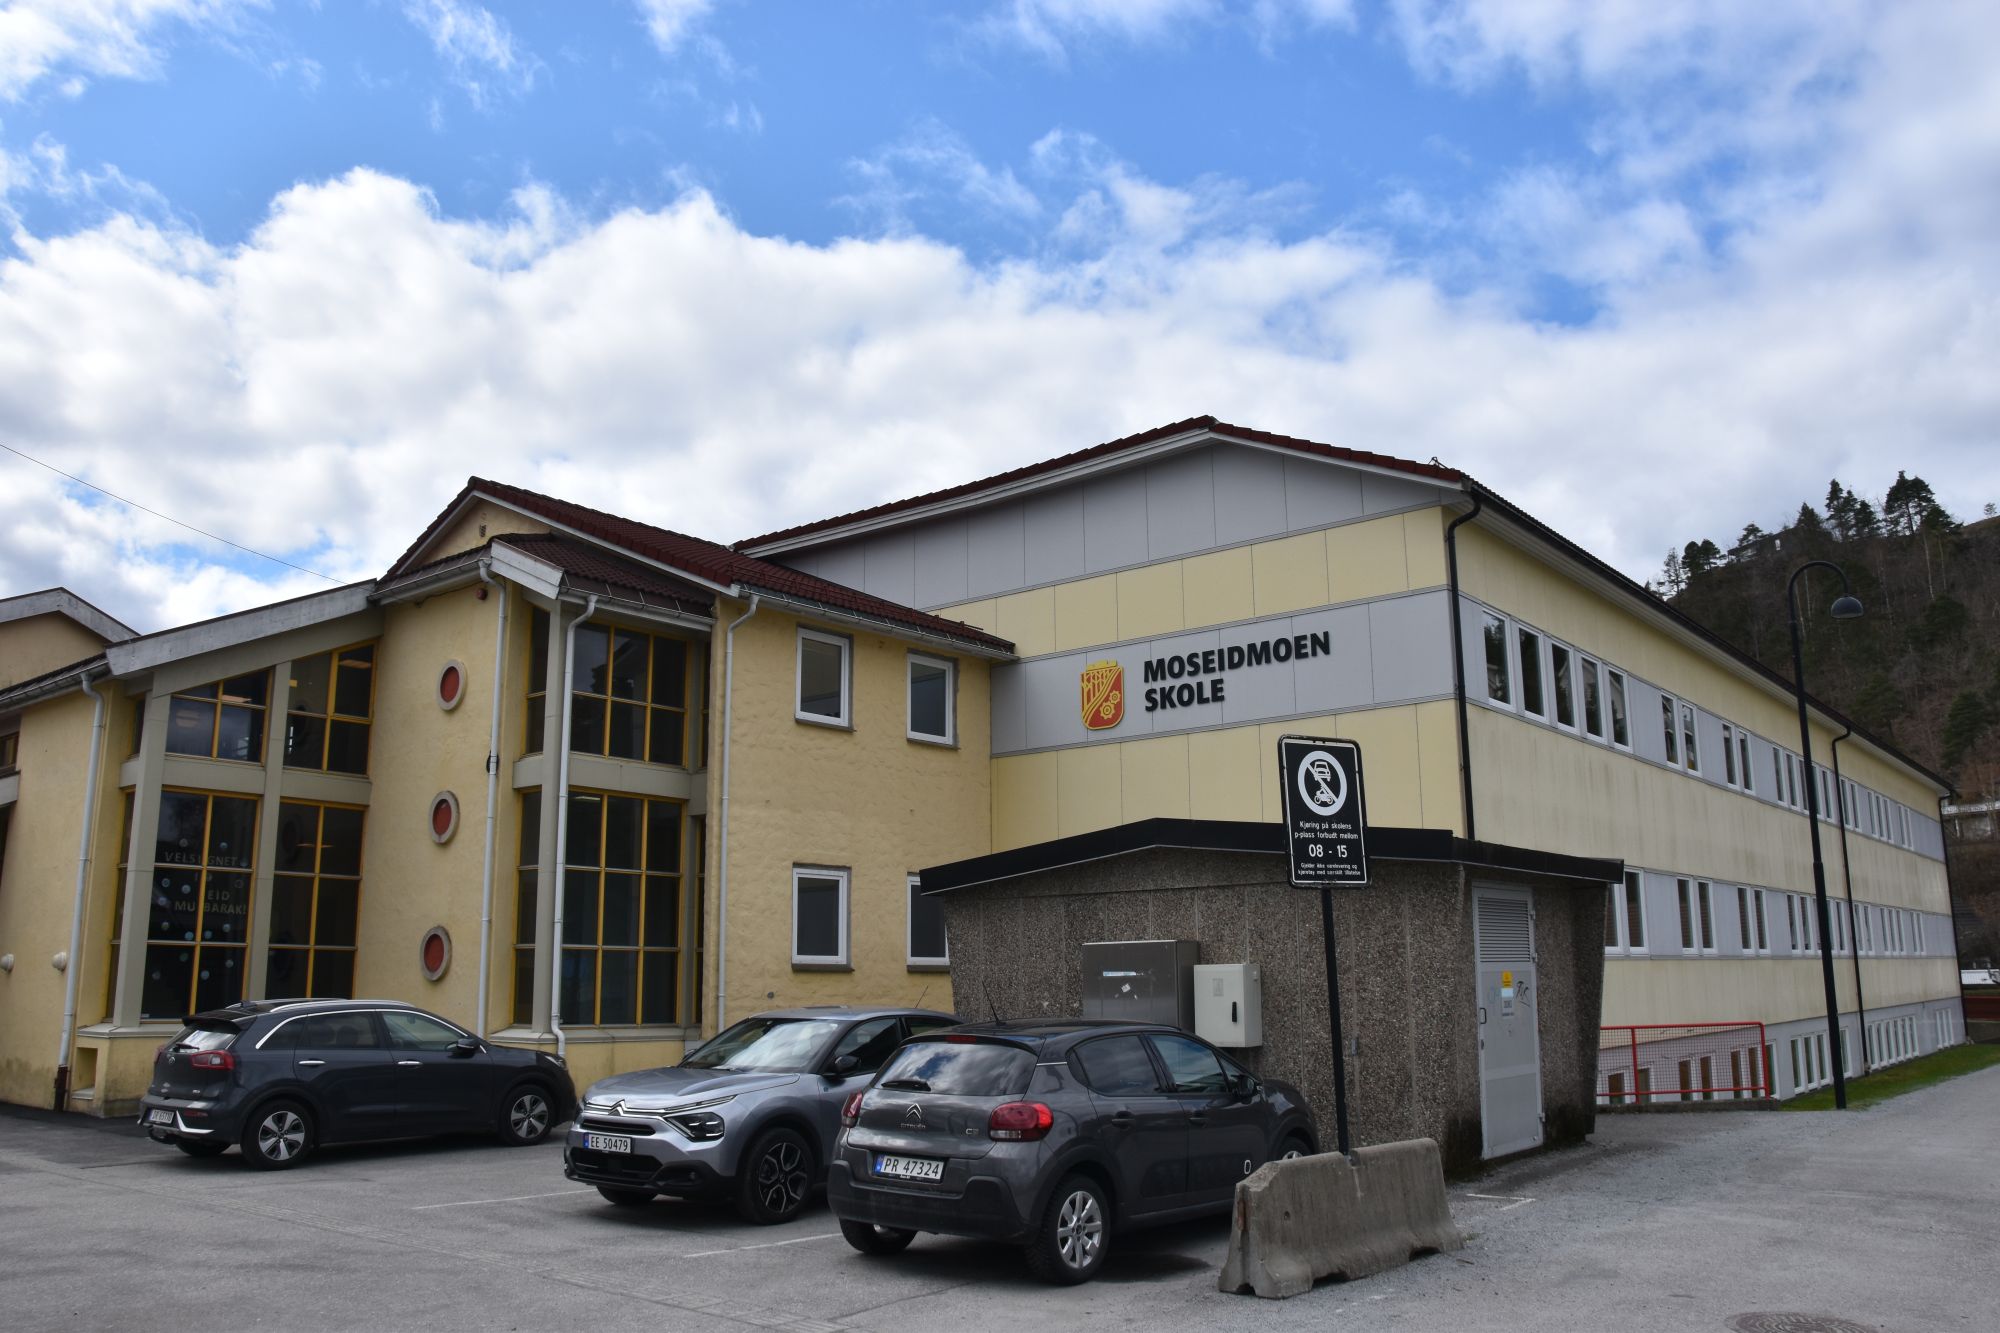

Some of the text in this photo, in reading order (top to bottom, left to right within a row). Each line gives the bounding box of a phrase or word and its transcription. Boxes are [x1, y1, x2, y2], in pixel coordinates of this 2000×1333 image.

[1144, 631, 1331, 683] MOSEIDMOEN
[1145, 679, 1225, 712] SKOLE
[1300, 821, 1319, 830] Kjøring
[1321, 822, 1329, 830] på
[1308, 844, 1324, 858] 08
[1336, 845, 1348, 858] 15
[591, 1136, 628, 1151] EE 50479
[884, 1158, 899, 1172] PR
[903, 1160, 939, 1177] 47324
